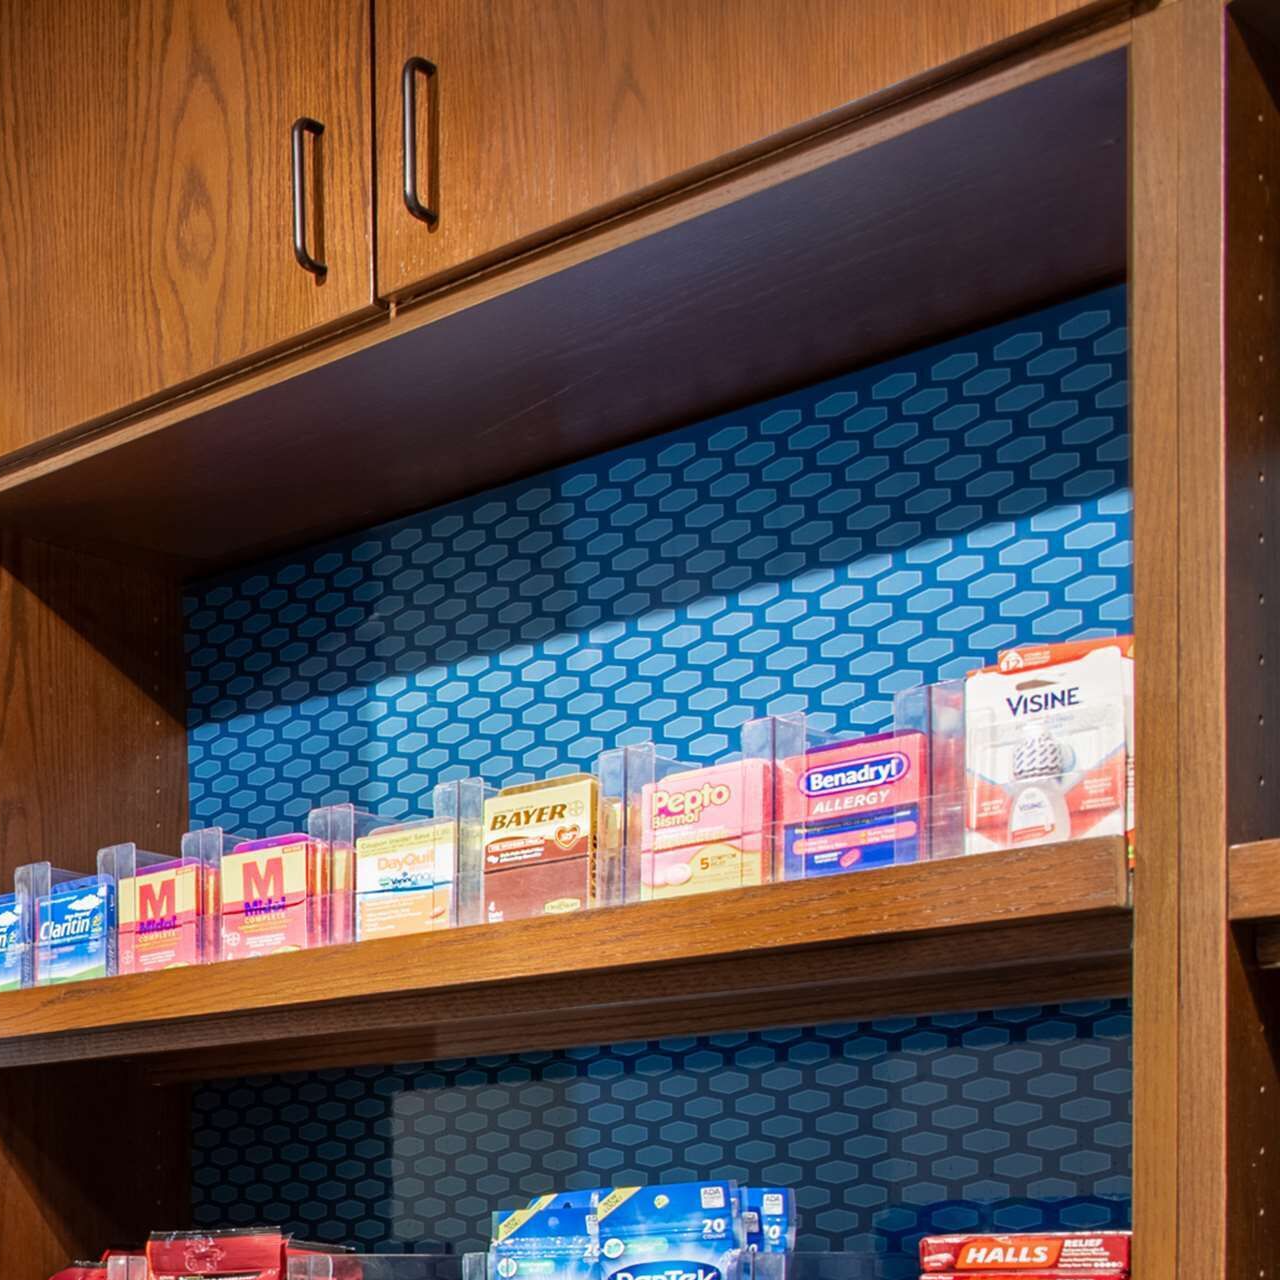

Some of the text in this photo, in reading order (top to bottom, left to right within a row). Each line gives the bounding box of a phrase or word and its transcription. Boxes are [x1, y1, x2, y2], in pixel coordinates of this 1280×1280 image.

[1006, 687, 1081, 716] VISINE
[810, 759, 899, 790] Benadryl
[652, 783, 730, 817] Pepto
[813, 789, 890, 815] ALLERGY
[490, 803, 567, 831] BAYER
[652, 807, 700, 829] Bismol
[377, 849, 434, 871] DayQuil
[700, 857, 709, 870] 5
[243, 857, 284, 899] M
[139, 878, 176, 921] M
[243, 897, 286, 916] Midol
[39, 915, 90, 941] Claritin
[139, 915, 177, 934] Midol
[702, 1218, 725, 1233] 20
[965, 1246, 1049, 1263] HALLS
[1064, 1238, 1104, 1247] RELIEF
